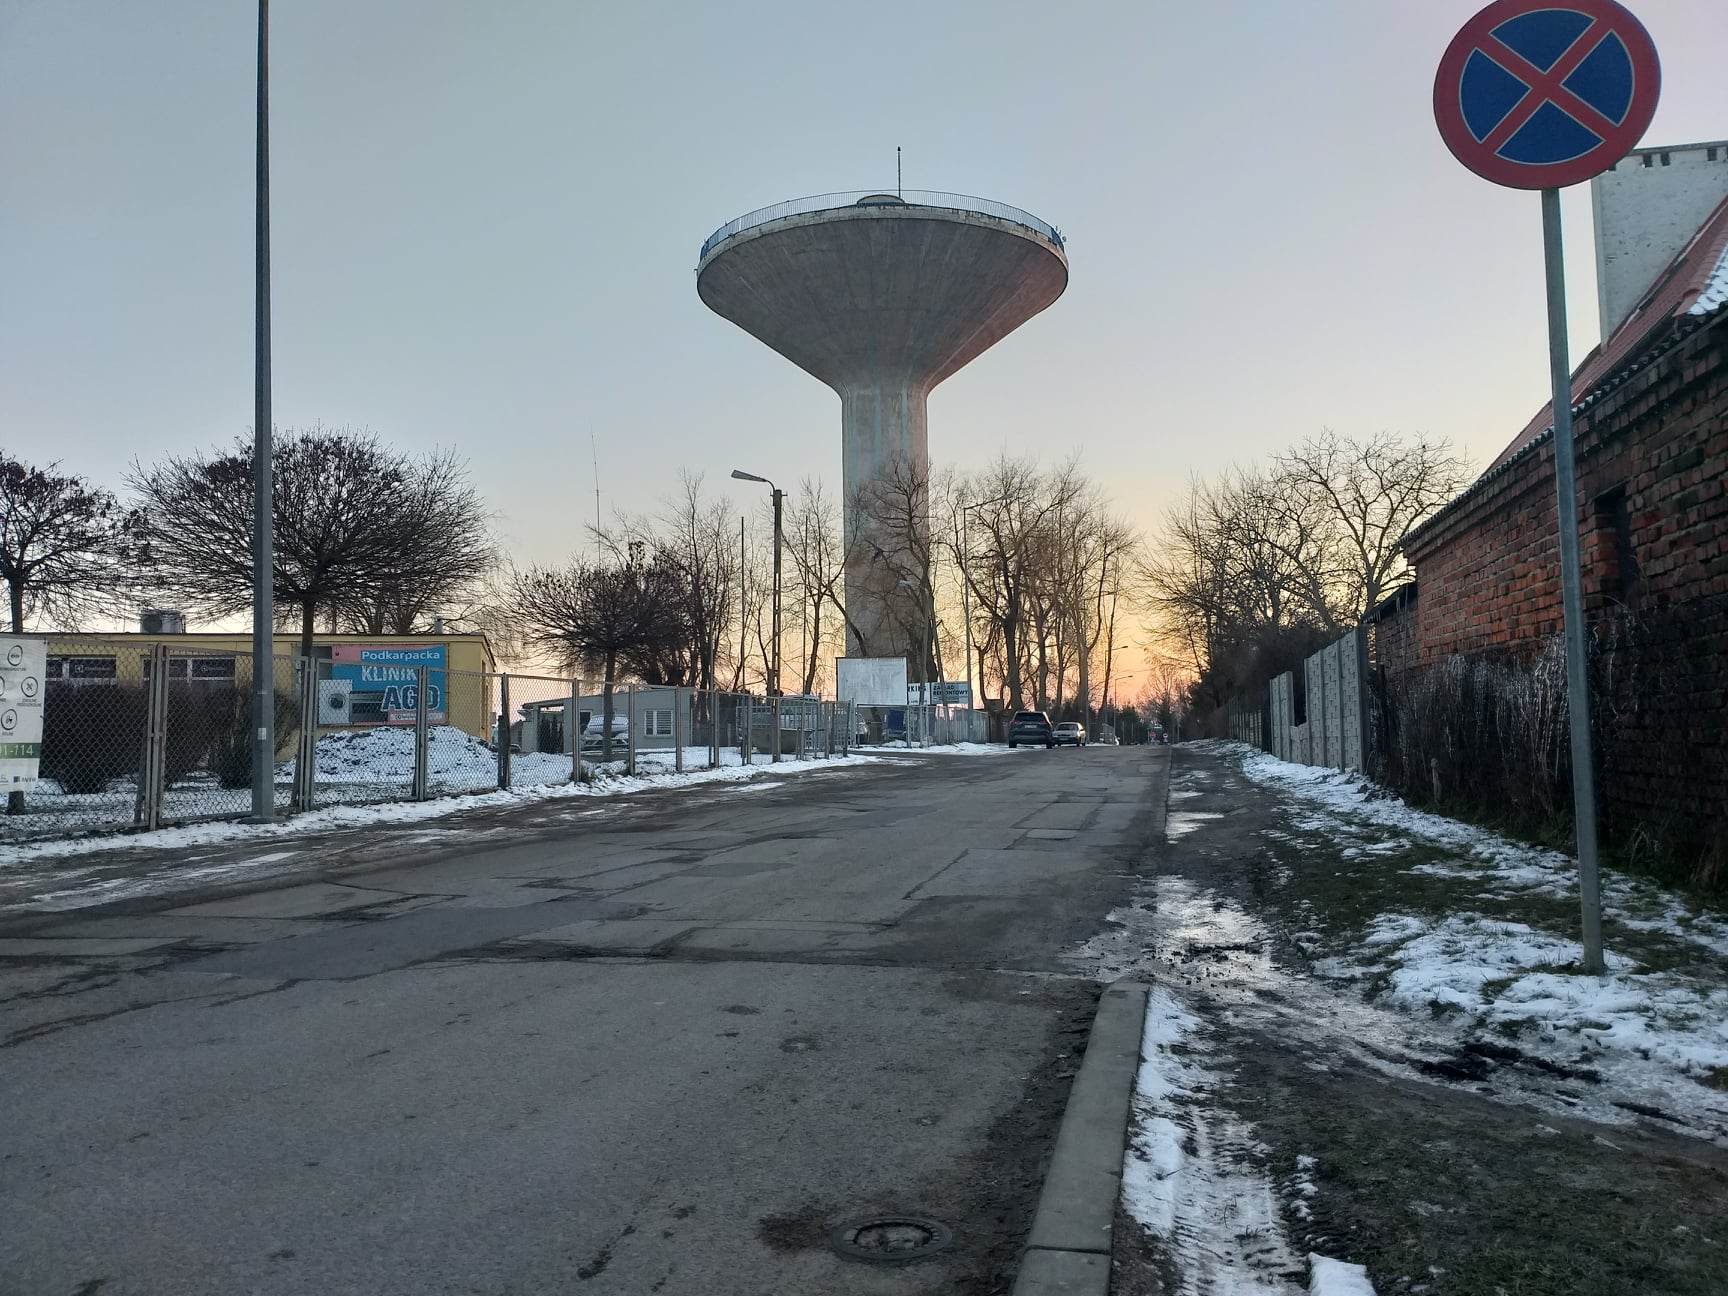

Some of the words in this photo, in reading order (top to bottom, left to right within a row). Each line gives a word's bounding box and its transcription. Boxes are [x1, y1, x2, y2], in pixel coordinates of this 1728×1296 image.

[361, 650, 440, 661] Podkarpacka
[361, 665, 419, 681] KLINIK
[380, 684, 440, 711] AGD
[0, 744, 35, 756] 1-114
